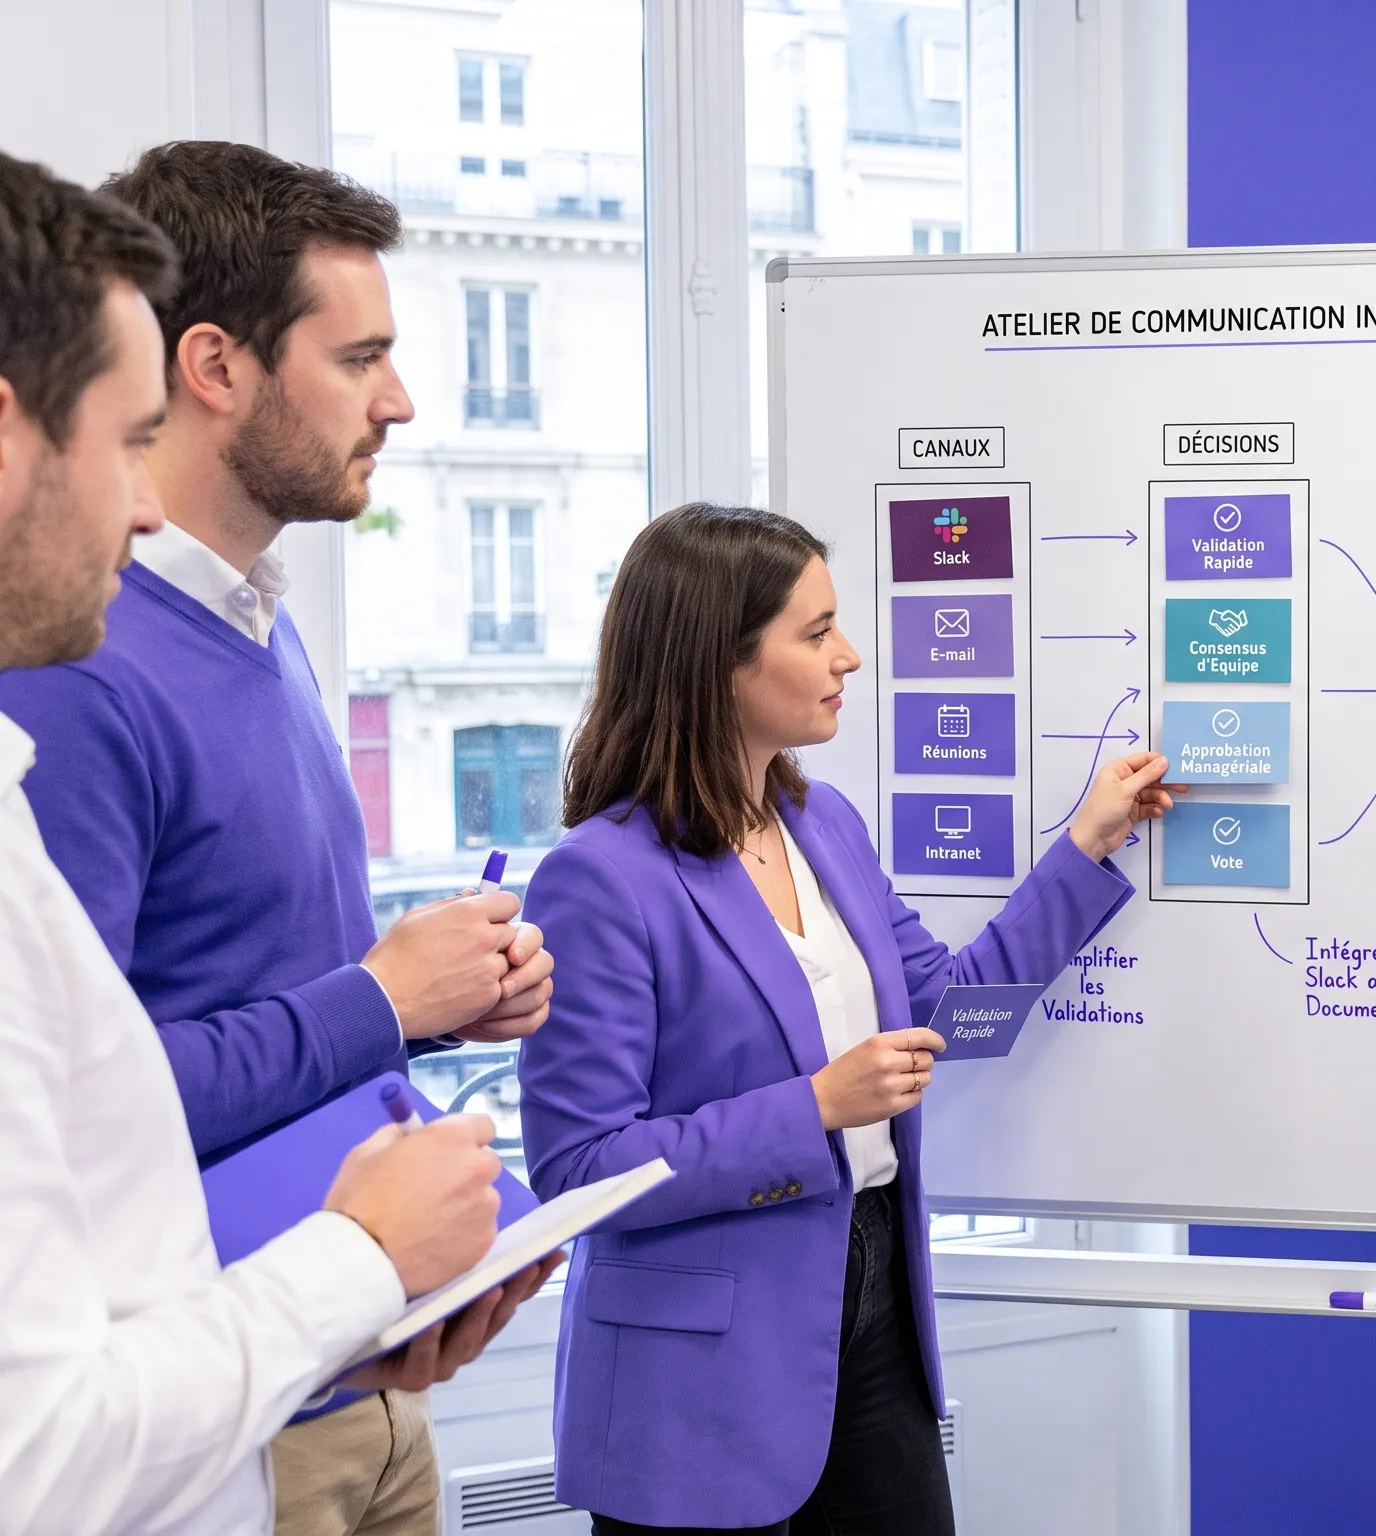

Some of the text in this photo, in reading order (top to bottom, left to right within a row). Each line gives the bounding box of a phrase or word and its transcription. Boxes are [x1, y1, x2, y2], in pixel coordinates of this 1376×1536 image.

[982, 311, 1081, 338] ATELIER
[1091, 311, 1122, 335] DE
[1131, 304, 1346, 333] COMMUNICATION
[913, 438, 990, 457] CANAUX
[1178, 431, 1279, 455] DÉCISIONS
[1192, 538, 1265, 552] Validation
[933, 550, 970, 565] Slack
[1204, 555, 1253, 572] Rapide
[930, 647, 975, 662] E-mail
[1189, 640, 1266, 655] Consensus
[1197, 657, 1259, 675] d'Equipe
[923, 743, 987, 759] Réunions
[1181, 743, 1271, 759] Approbation
[1181, 760, 1271, 777] Managériale
[925, 846, 981, 860] Intranet
[1210, 855, 1243, 869] Vote
[1070, 946, 1138, 976] mplifier
[1081, 973, 1104, 995] les
[1305, 968, 1357, 989] Slack
[953, 1008, 1012, 1022] Validation
[1042, 999, 1144, 1024] Validations
[953, 1025, 995, 1041] Rapide
